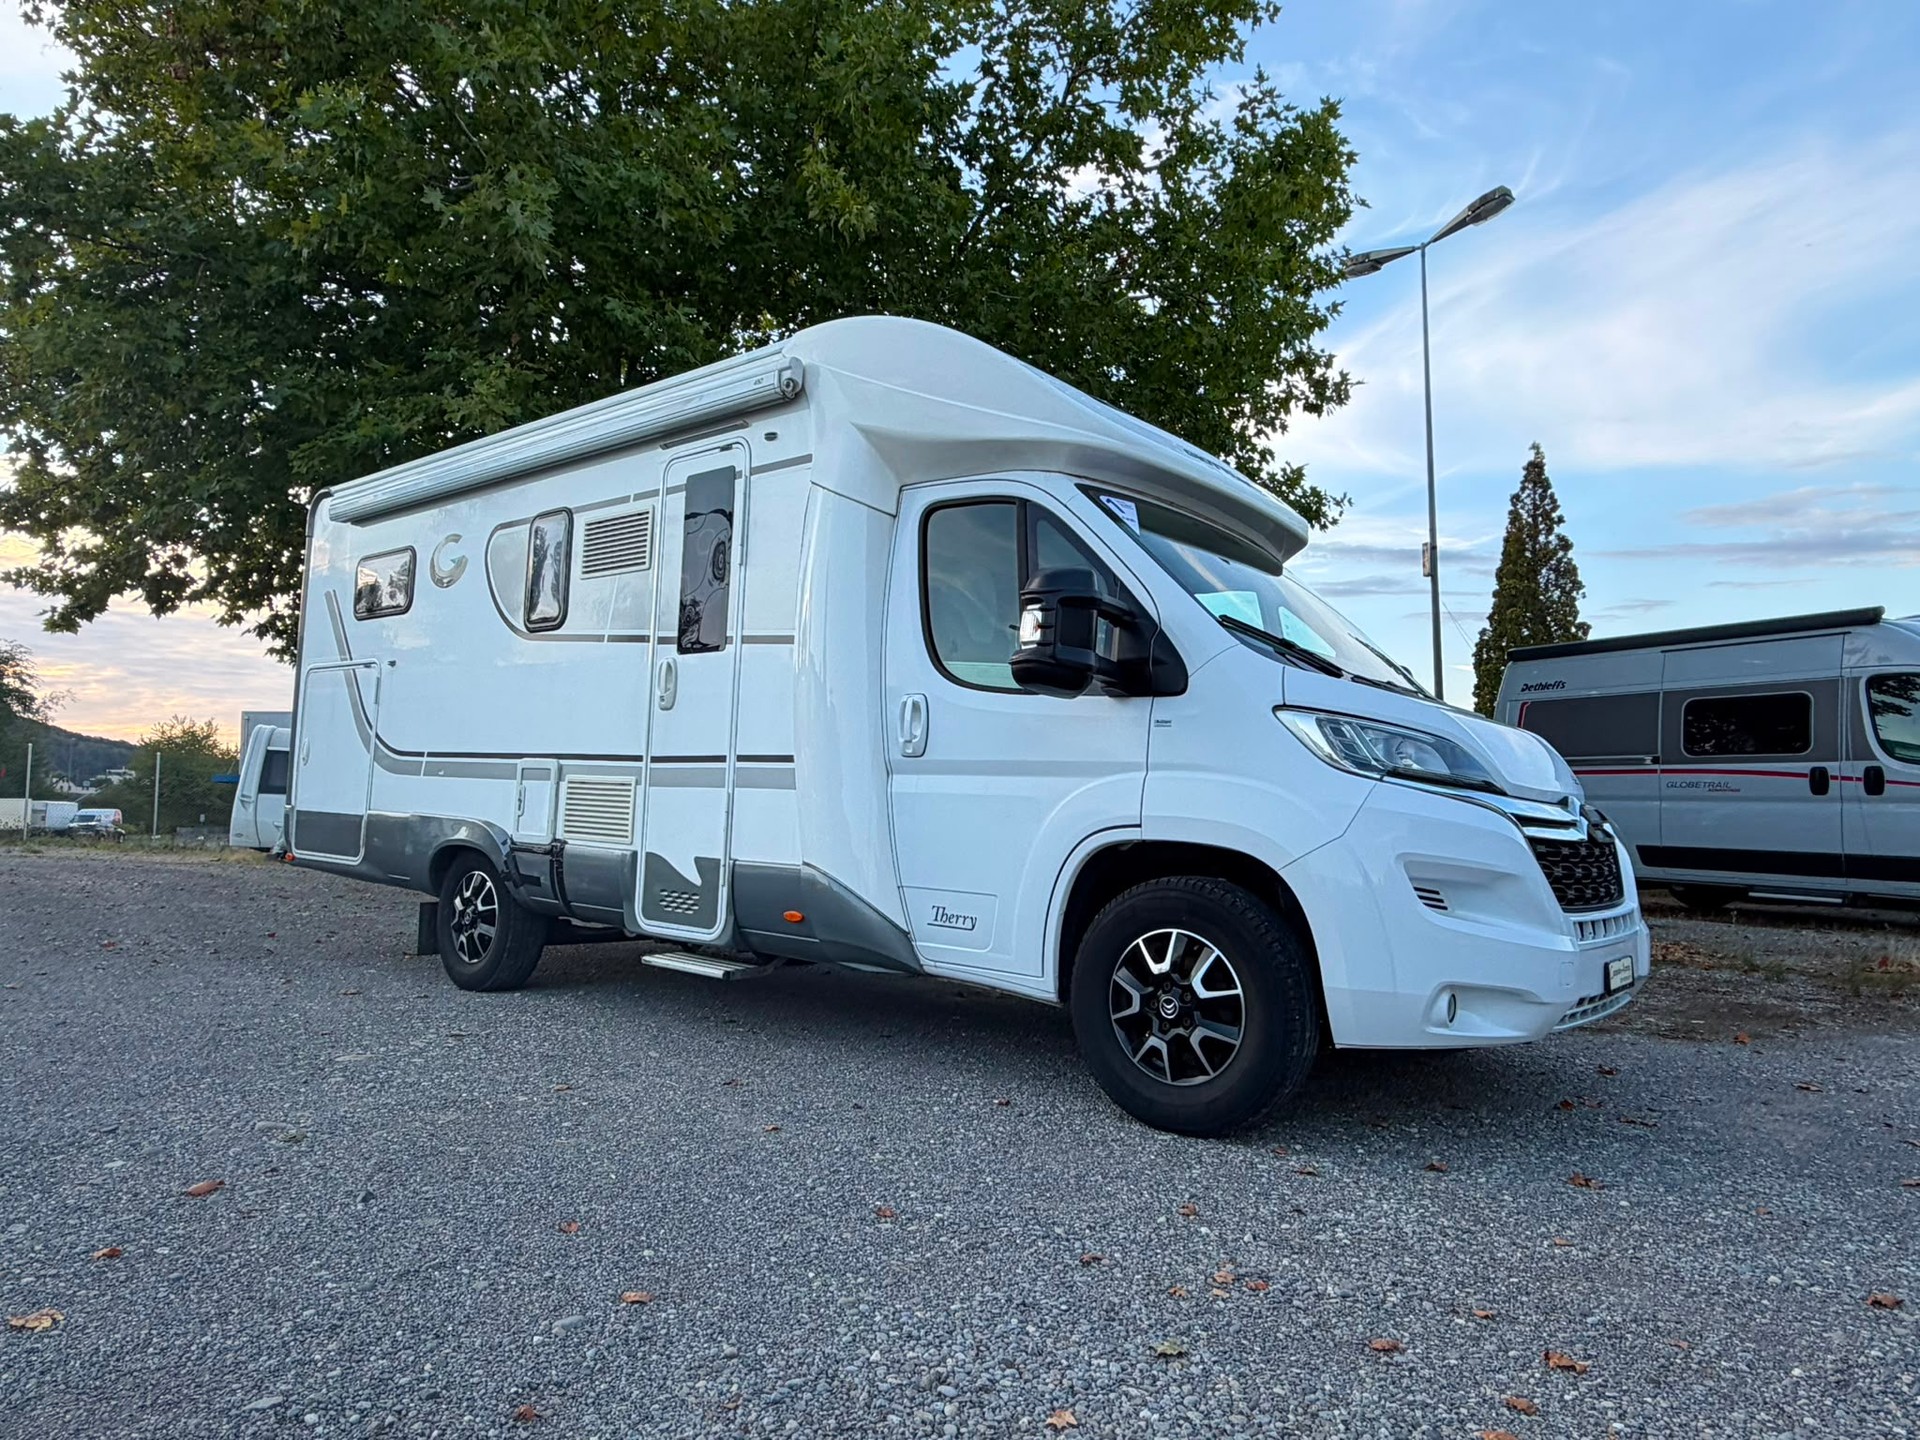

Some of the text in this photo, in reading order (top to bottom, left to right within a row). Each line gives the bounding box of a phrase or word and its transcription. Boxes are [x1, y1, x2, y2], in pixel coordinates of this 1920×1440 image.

[1520, 680, 1567, 693] Dethleffs
[1666, 781, 1732, 789] GLOBETRAIL
[931, 905, 978, 931] Therry
